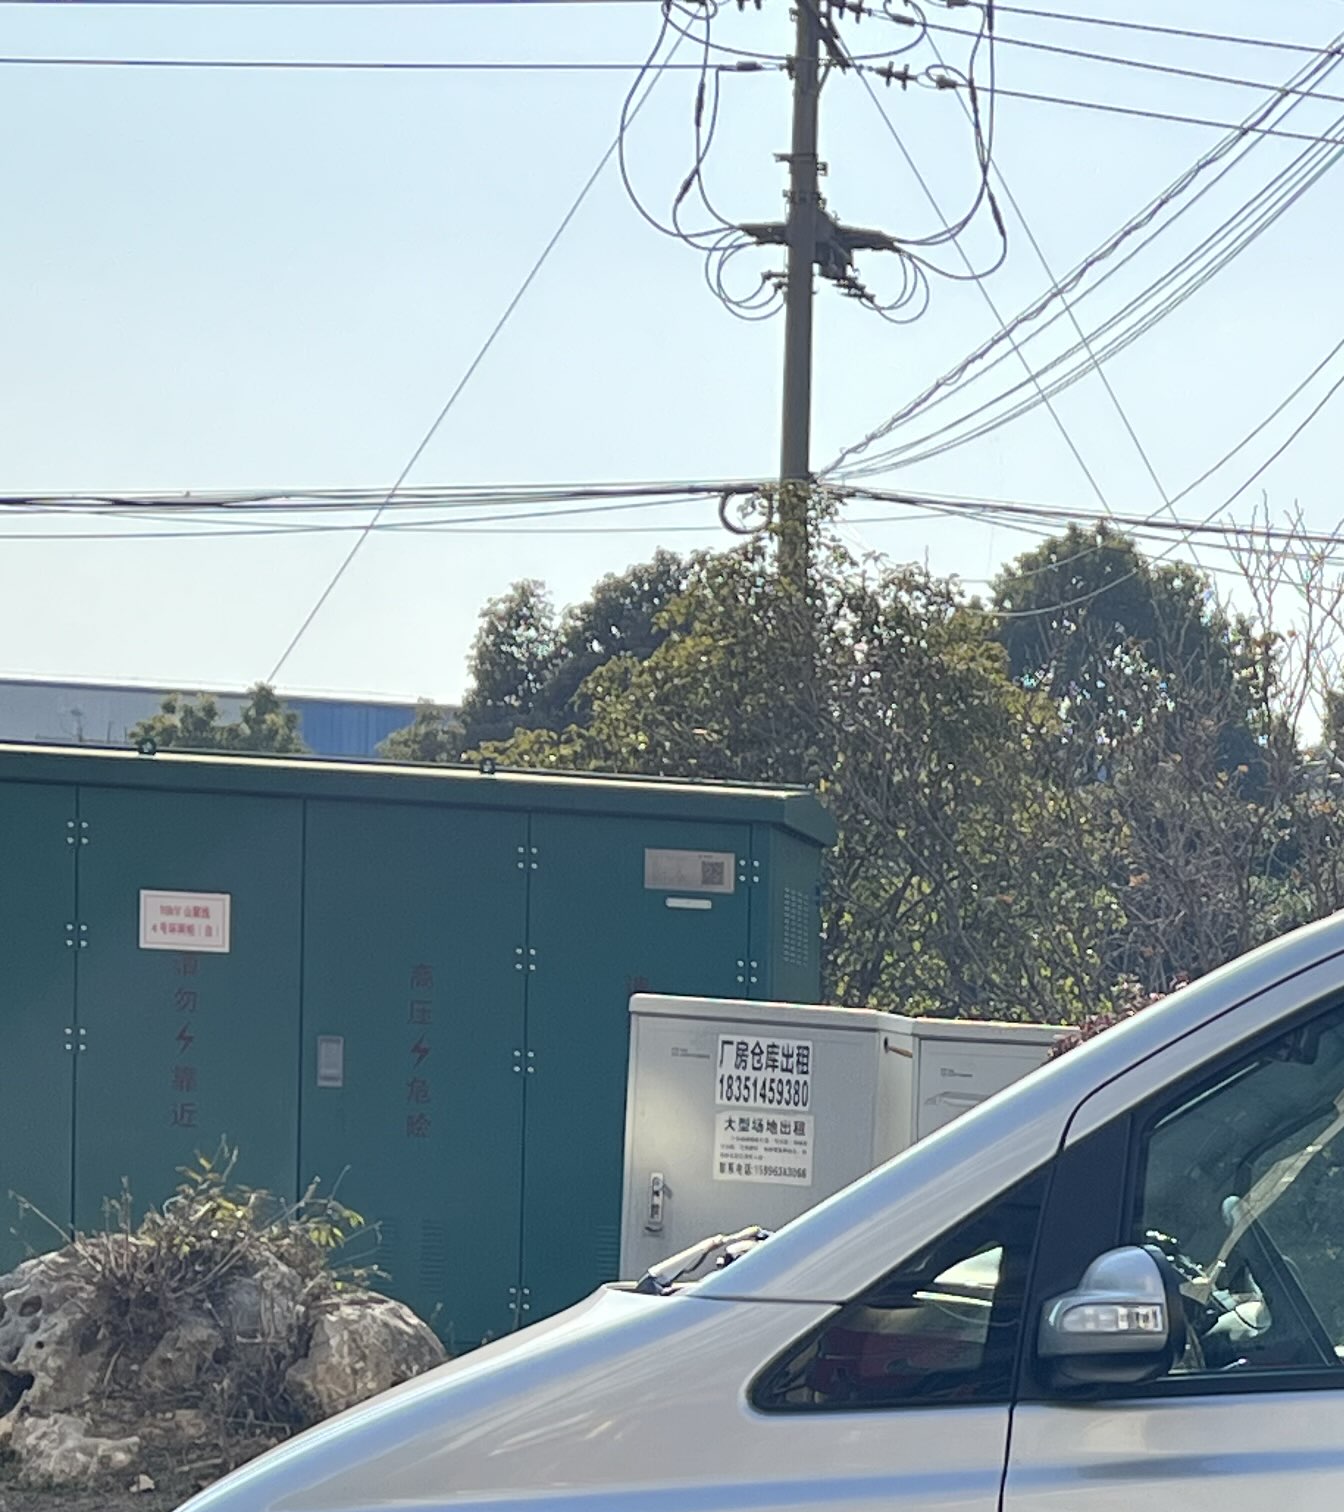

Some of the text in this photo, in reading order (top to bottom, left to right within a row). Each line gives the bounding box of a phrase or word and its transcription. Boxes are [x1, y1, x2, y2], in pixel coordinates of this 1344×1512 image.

[719, 1040, 810, 1075] 厂房仓库出租
[719, 1074, 809, 1107] 18351459380
[724, 1115, 806, 1137] 大型场地出租
